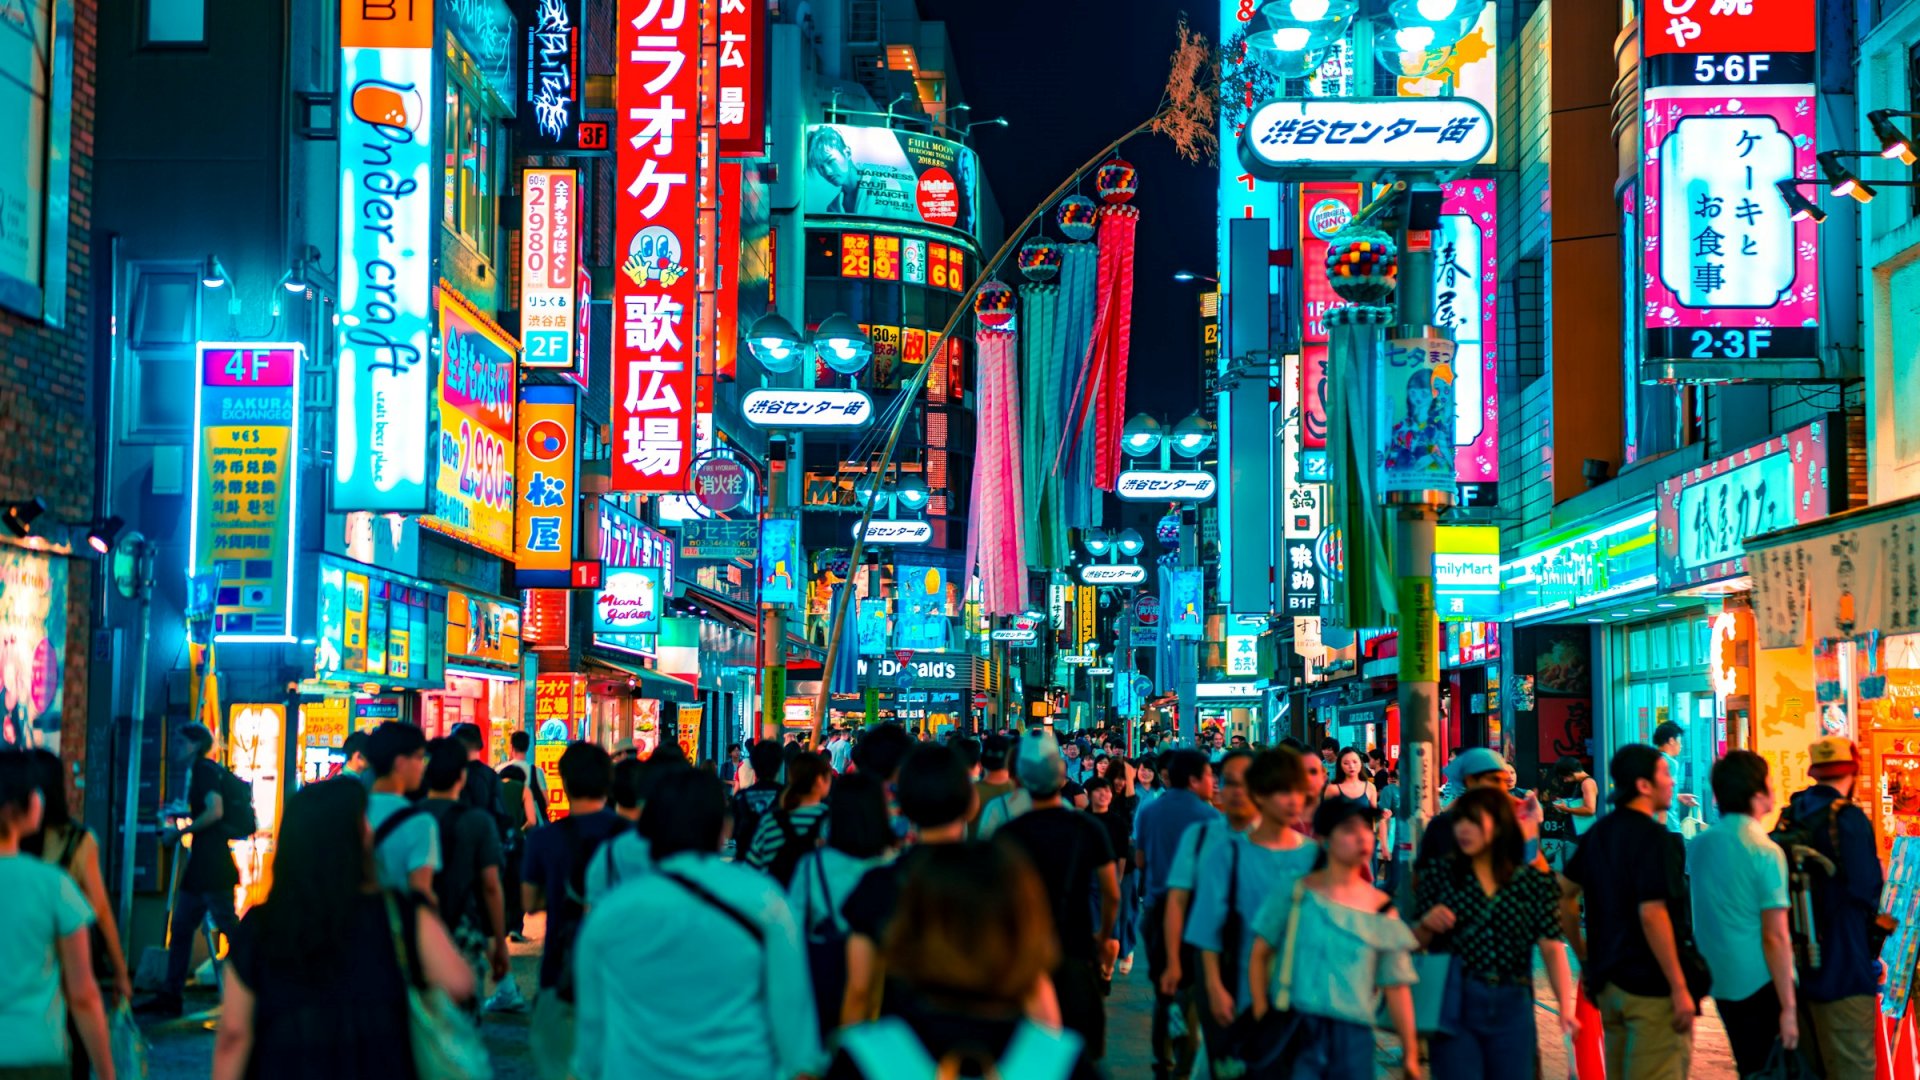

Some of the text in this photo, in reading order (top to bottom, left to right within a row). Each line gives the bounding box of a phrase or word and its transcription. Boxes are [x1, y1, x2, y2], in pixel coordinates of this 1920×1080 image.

[583, 126, 604, 145] 3F
[1260, 116, 1481, 145] 渋谷センター街
[857, 169, 914, 181] DARKNESS
[1735, 129, 1763, 256] ケーキと
[1315, 207, 1346, 222] BURGER
[1316, 214, 1347, 232] KING
[553, 180, 569, 284] 全身もみほぐし
[1692, 192, 1726, 294] お食事
[528, 296, 567, 308] りらくる
[528, 315, 568, 328] 渋谷店
[531, 336, 564, 357] 2F
[224, 349, 270, 381] 4F
[622, 293, 684, 477] 歌広場
[222, 397, 293, 410] SAKURA
[748, 400, 866, 416] 渋谷センター街
[222, 409, 281, 420] EXCHANGE
[699, 473, 744, 496] 消火栓
[1122, 479, 1212, 491] 渋谷センター街
[525, 472, 566, 552] 松屋
[1084, 568, 1141, 579] 渋谷センター街
[1436, 561, 1493, 577] milyMart
[596, 593, 644, 607] Miami
[1289, 597, 1316, 609] B1F
[536, 679, 570, 696] ラオケ
